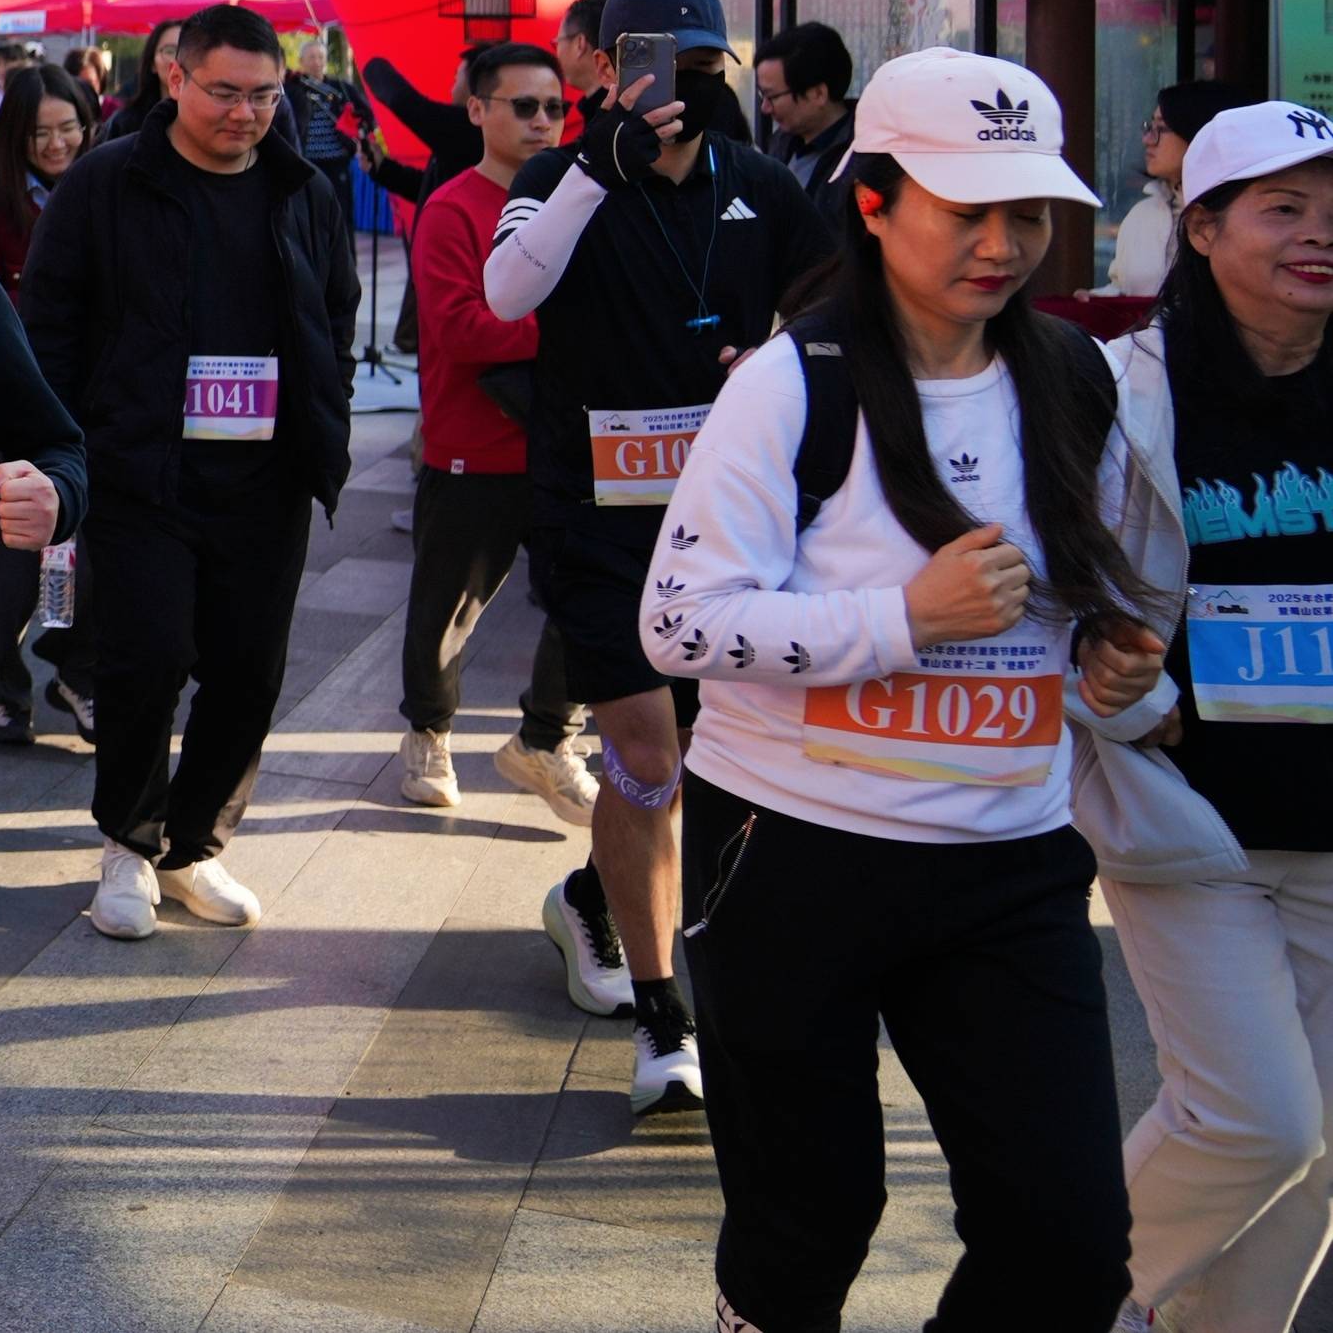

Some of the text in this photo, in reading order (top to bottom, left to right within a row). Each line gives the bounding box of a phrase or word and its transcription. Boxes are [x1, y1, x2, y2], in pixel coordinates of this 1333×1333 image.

[977, 126, 1037, 142] adidas
[183, 382, 258, 415] 1041
[845, 678, 1038, 740] G1029
